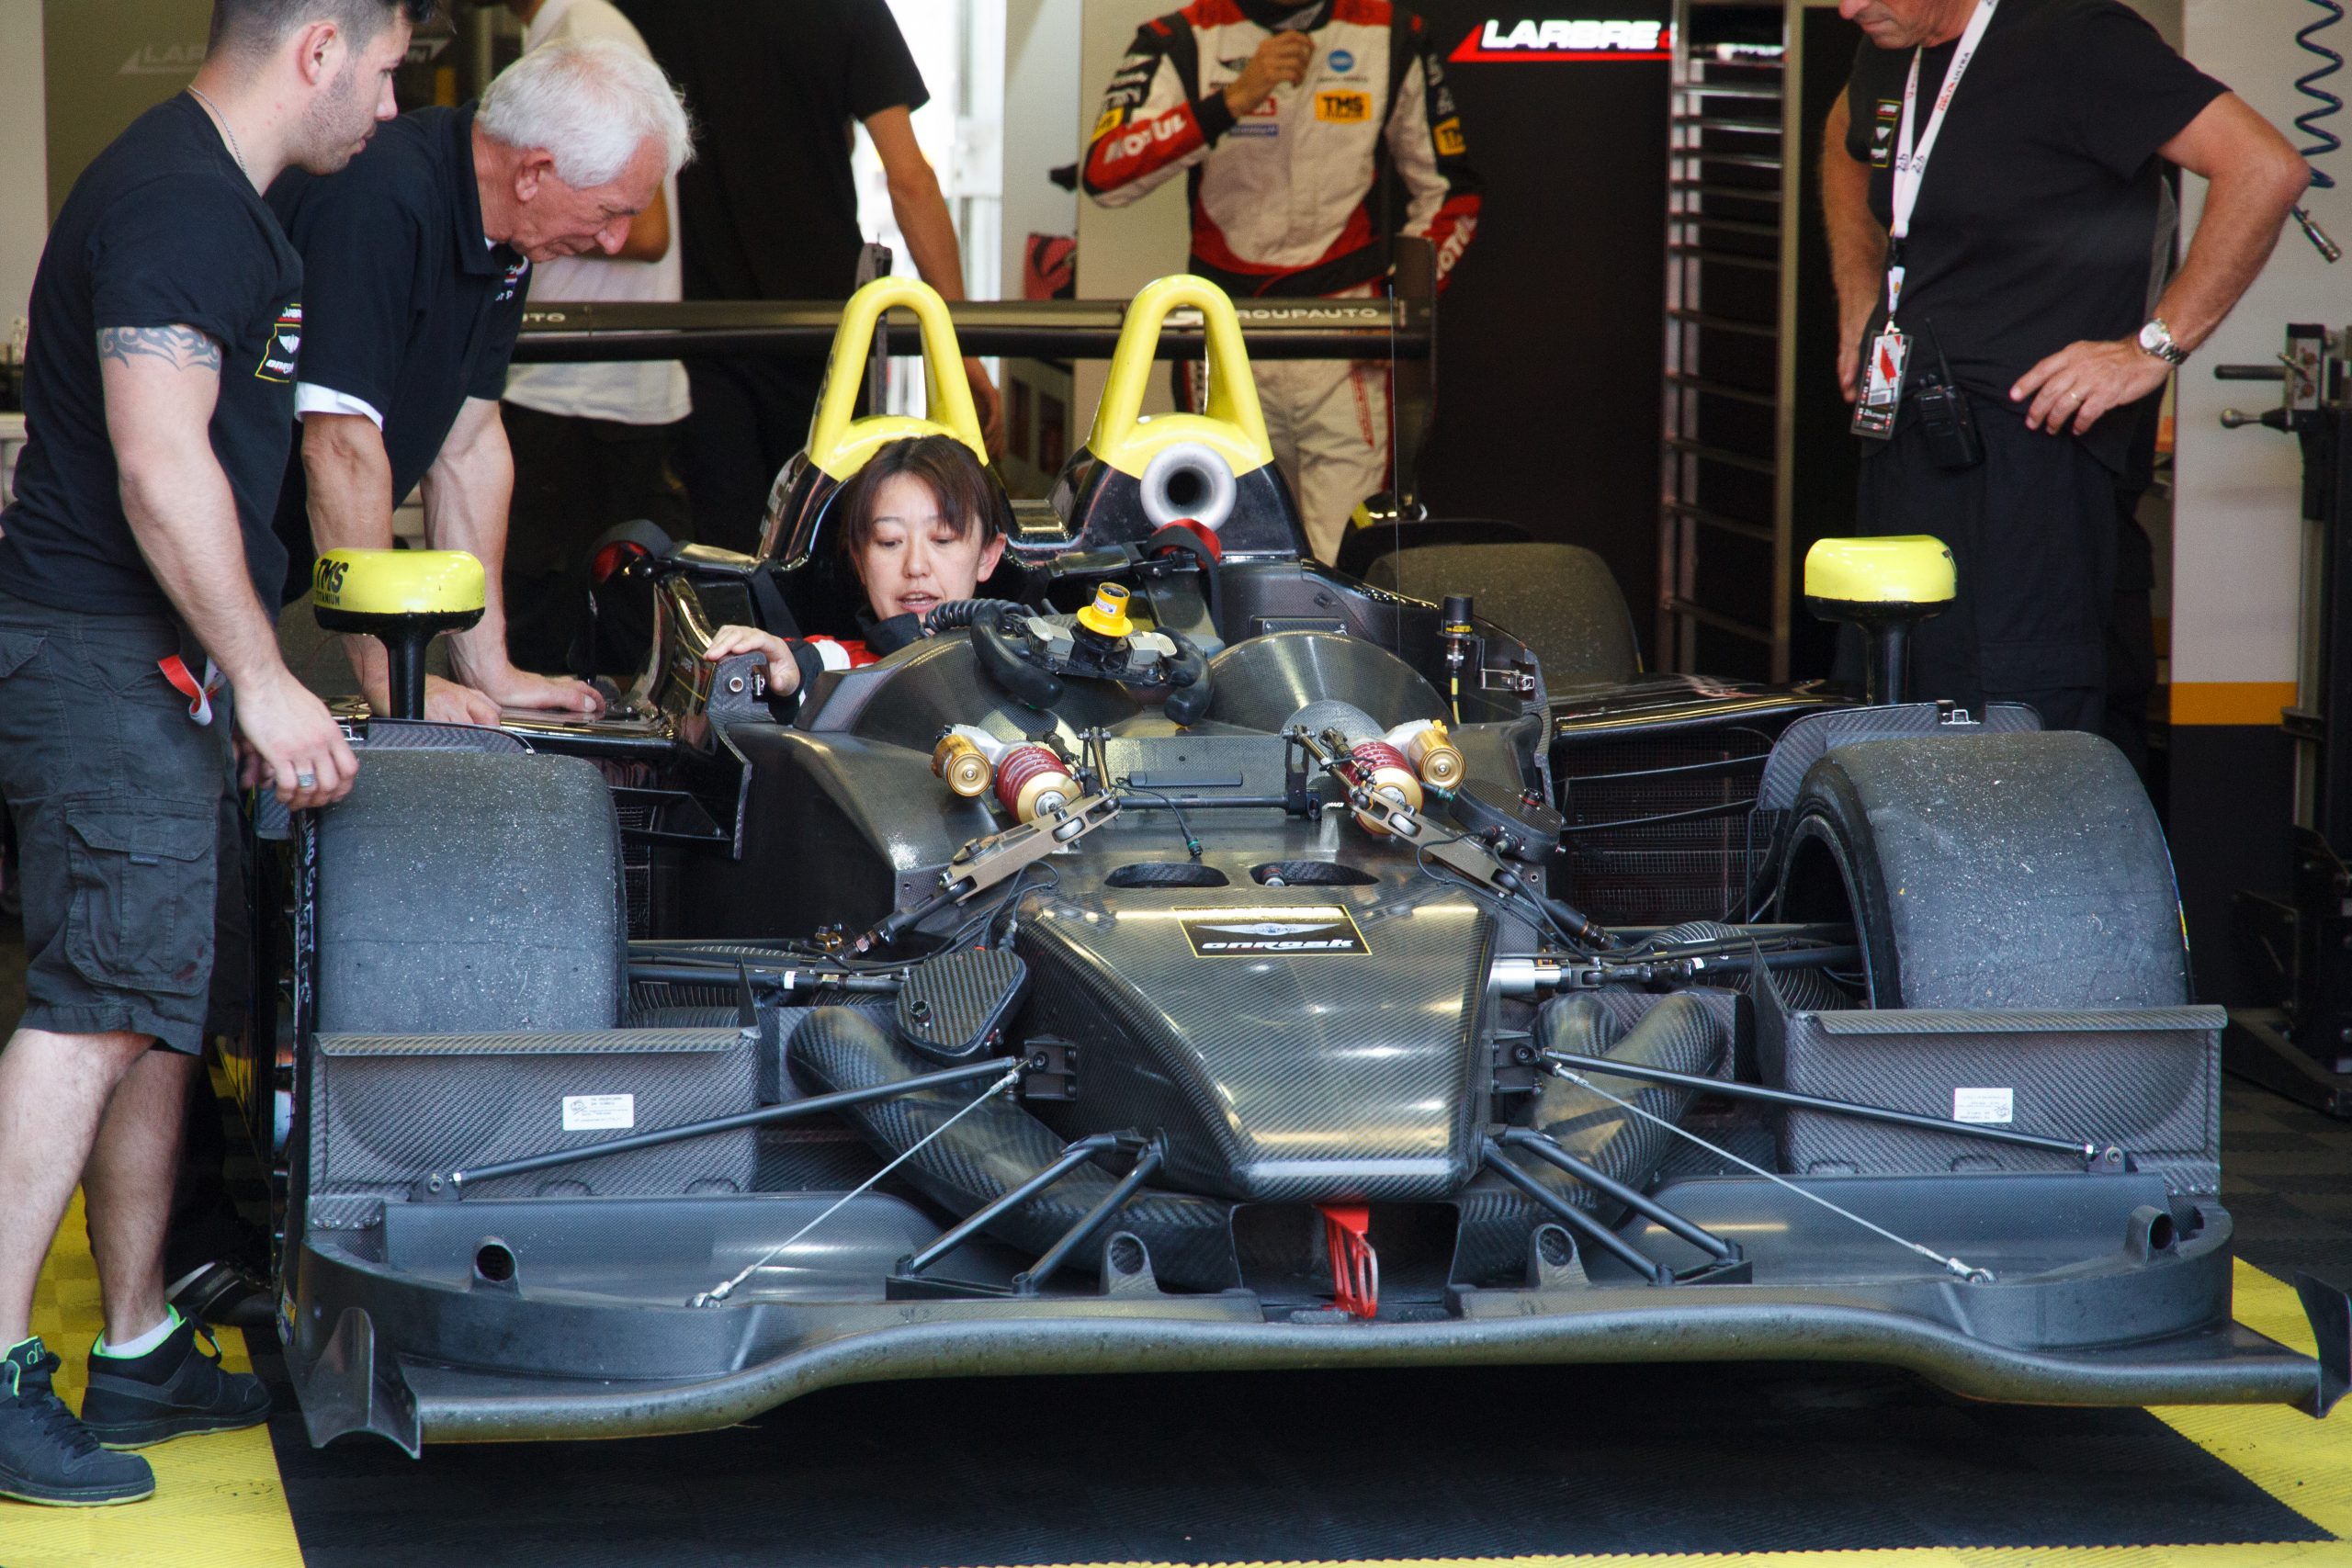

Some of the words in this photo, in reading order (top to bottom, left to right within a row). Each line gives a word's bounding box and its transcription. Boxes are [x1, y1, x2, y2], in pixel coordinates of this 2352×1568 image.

[1480, 19, 1662, 51] LARBRE
[1235, 308, 1378, 320] ROUPAUTO
[316, 558, 349, 593] TMS
